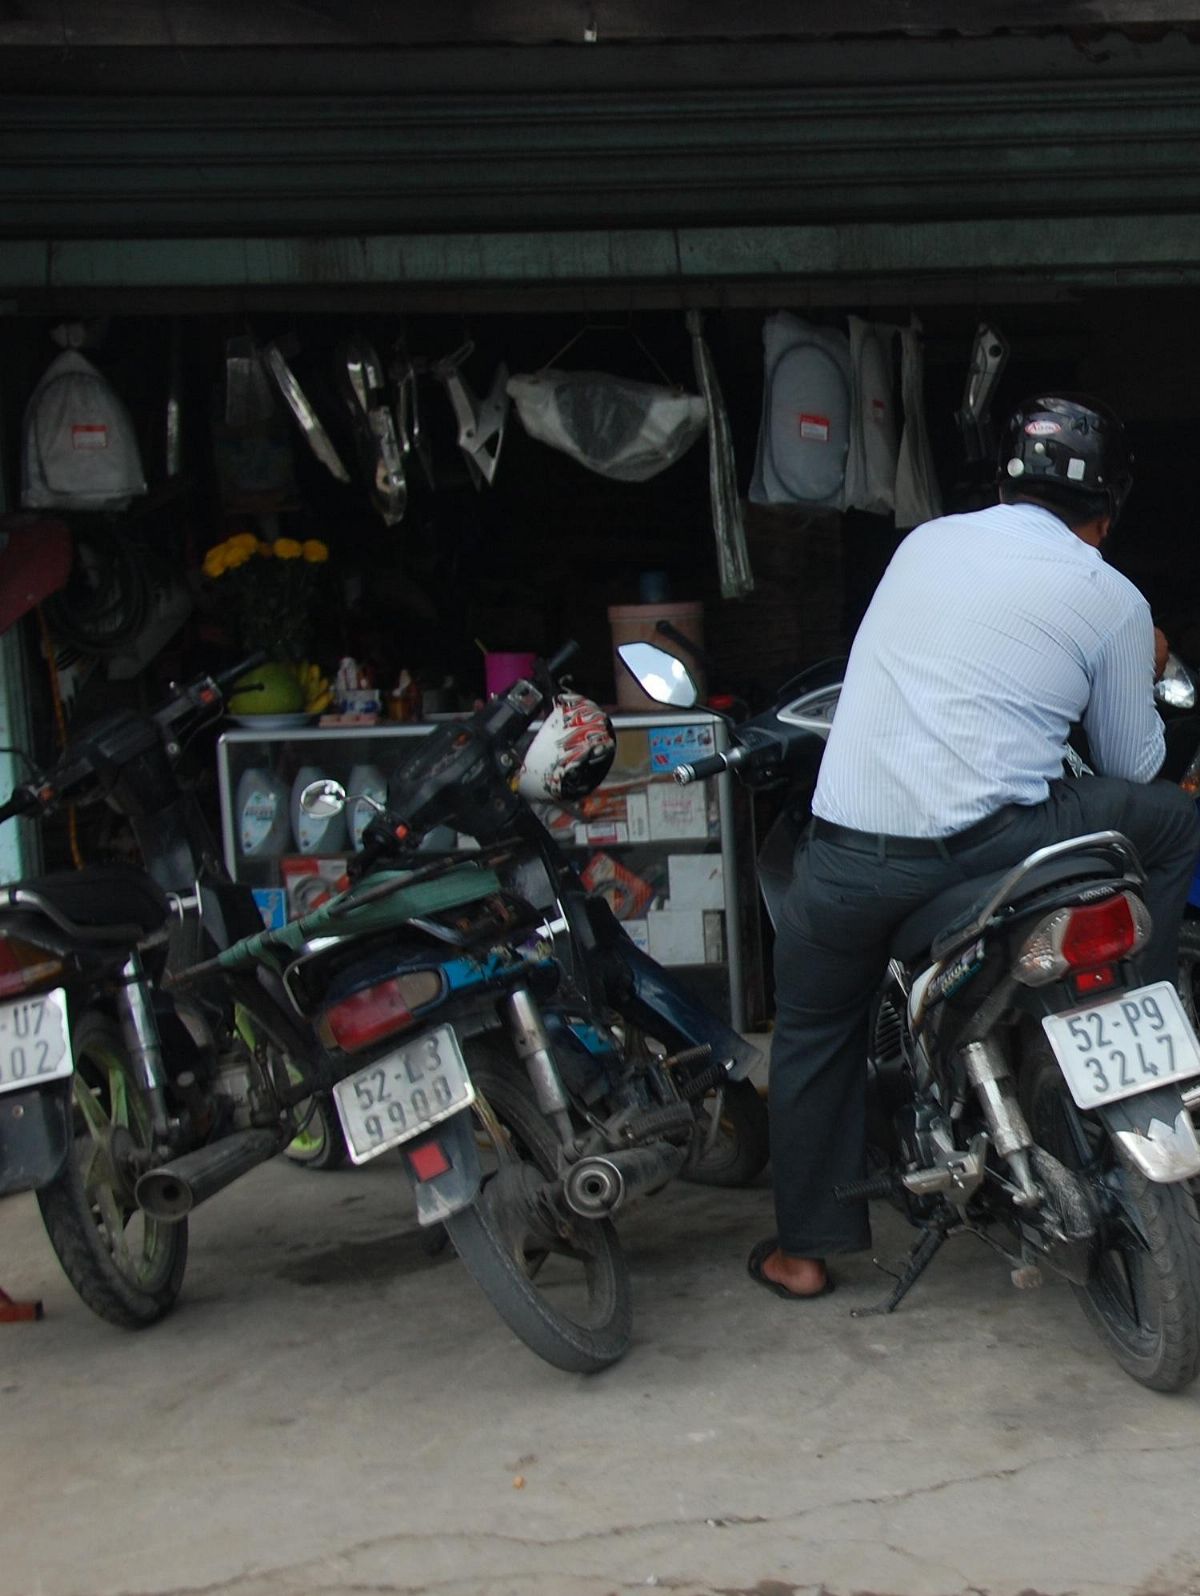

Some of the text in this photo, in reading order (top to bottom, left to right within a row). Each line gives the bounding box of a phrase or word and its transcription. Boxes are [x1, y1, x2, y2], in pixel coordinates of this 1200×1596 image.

[1066, 996, 1165, 1053] 52-P9
[0, 1040, 50, 1080] 02
[352, 1036, 442, 1110] 52-L3
[1085, 1034, 1176, 1093] 3247
[363, 1075, 453, 1146] 9900
